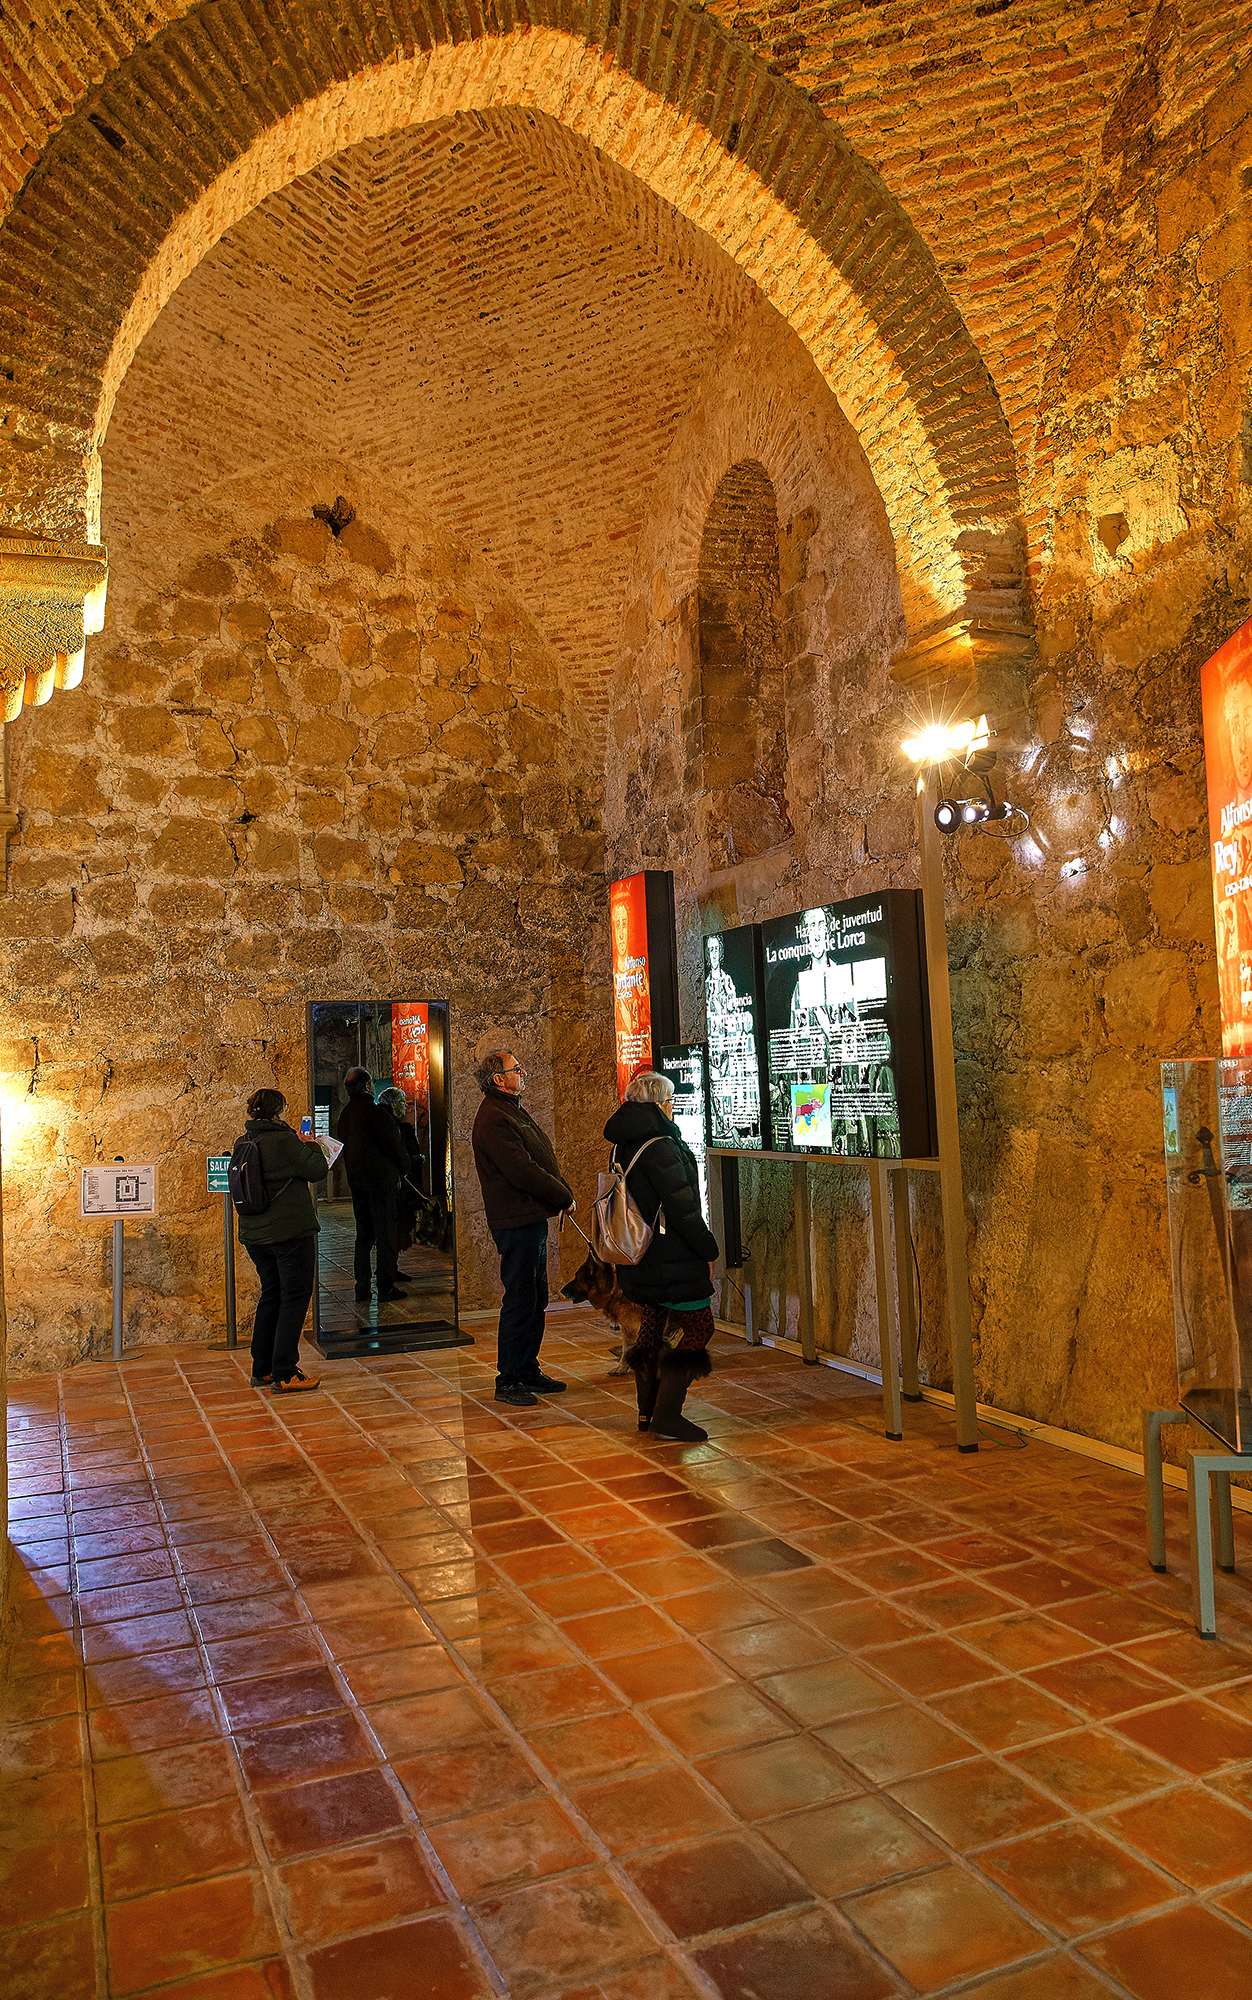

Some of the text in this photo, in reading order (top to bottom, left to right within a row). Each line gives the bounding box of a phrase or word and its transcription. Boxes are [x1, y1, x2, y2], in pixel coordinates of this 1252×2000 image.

[1221, 799, 1252, 833] Alfons
[1213, 841, 1238, 876] Rey
[830, 917, 840, 931] de
[841, 905, 882, 933] juventud
[766, 947, 777, 963] La
[825, 934, 836, 951] de
[837, 931, 865, 949] Lorca
[625, 956, 646, 970] Alfonso
[616, 971, 643, 990] Infante
